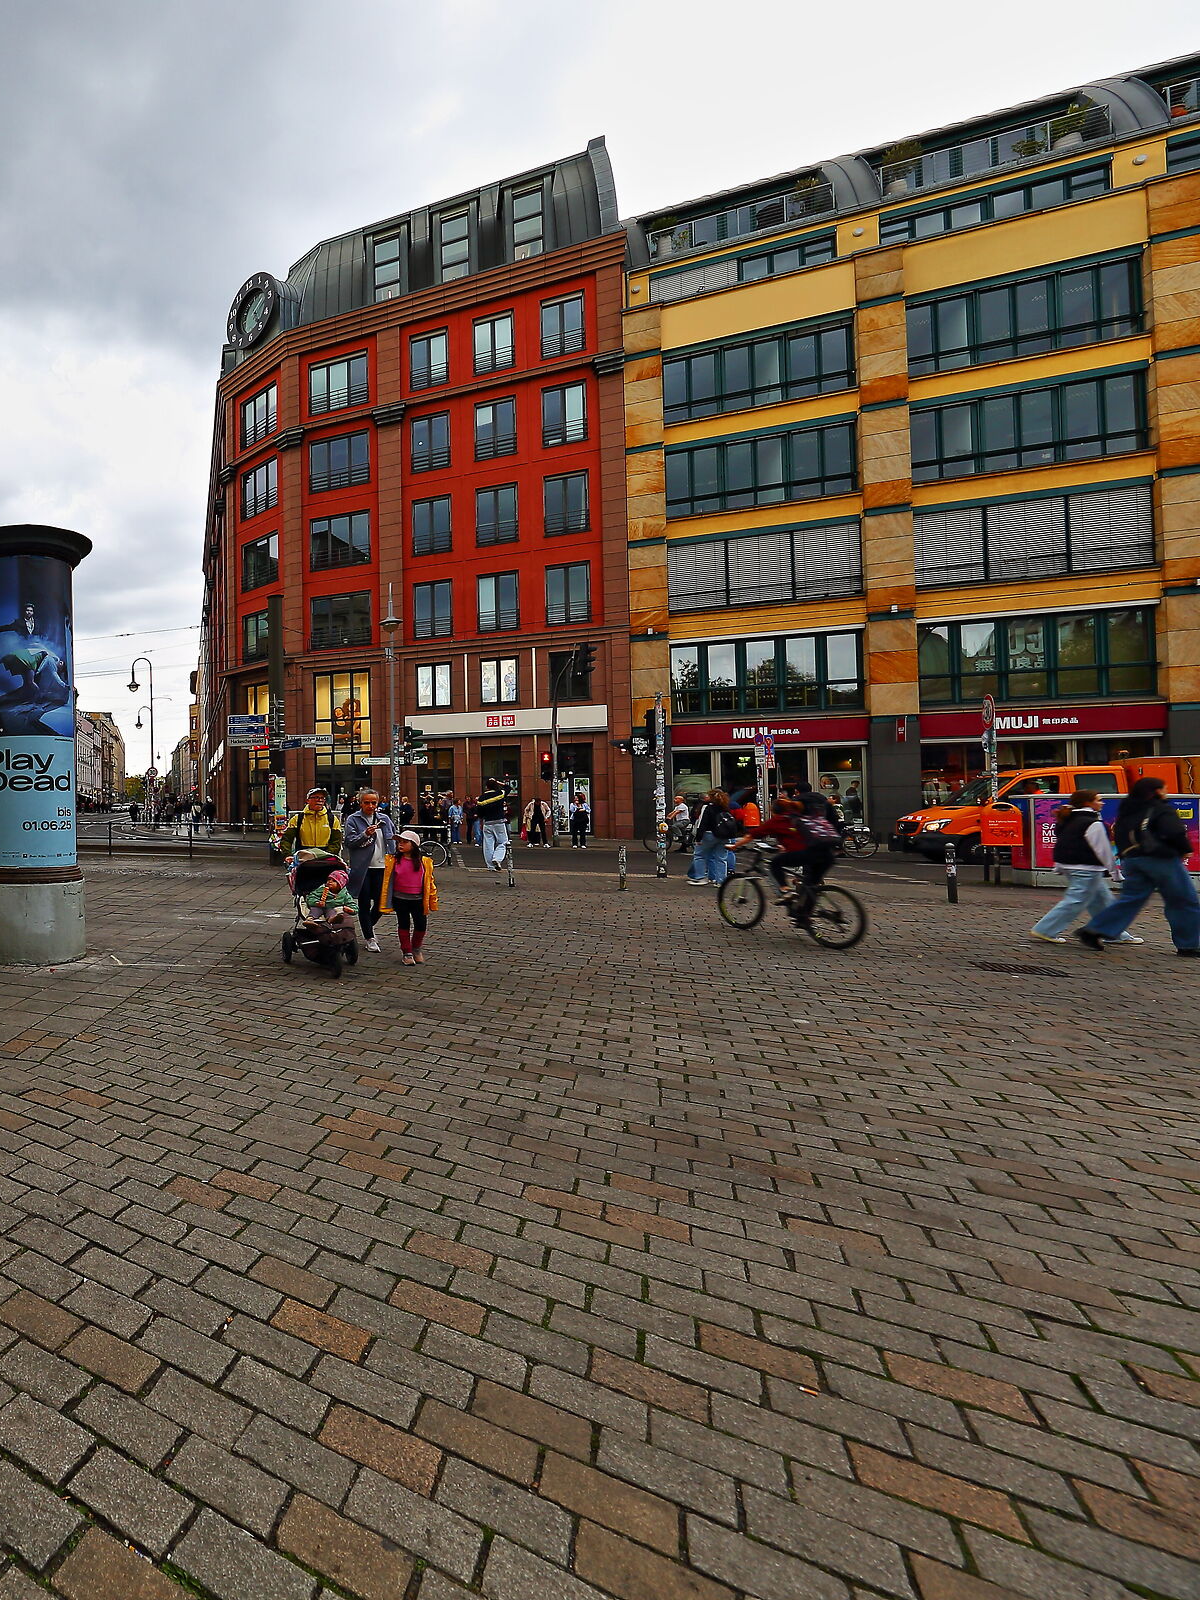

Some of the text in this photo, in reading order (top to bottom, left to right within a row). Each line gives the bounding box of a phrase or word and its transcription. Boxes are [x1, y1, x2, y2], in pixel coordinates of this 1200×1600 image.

[245, 280, 253, 291] 12
[264, 280, 269, 289] 2
[236, 294, 242, 304] 11
[230, 309, 236, 319] 10
[258, 322, 262, 330] 5
[239, 338, 243, 346] 7
[248, 334, 252, 342] 6
[994, 715, 1039, 730] MUJI
[57, 807, 72, 817] bis
[22, 821, 72, 831] 01.06.25
